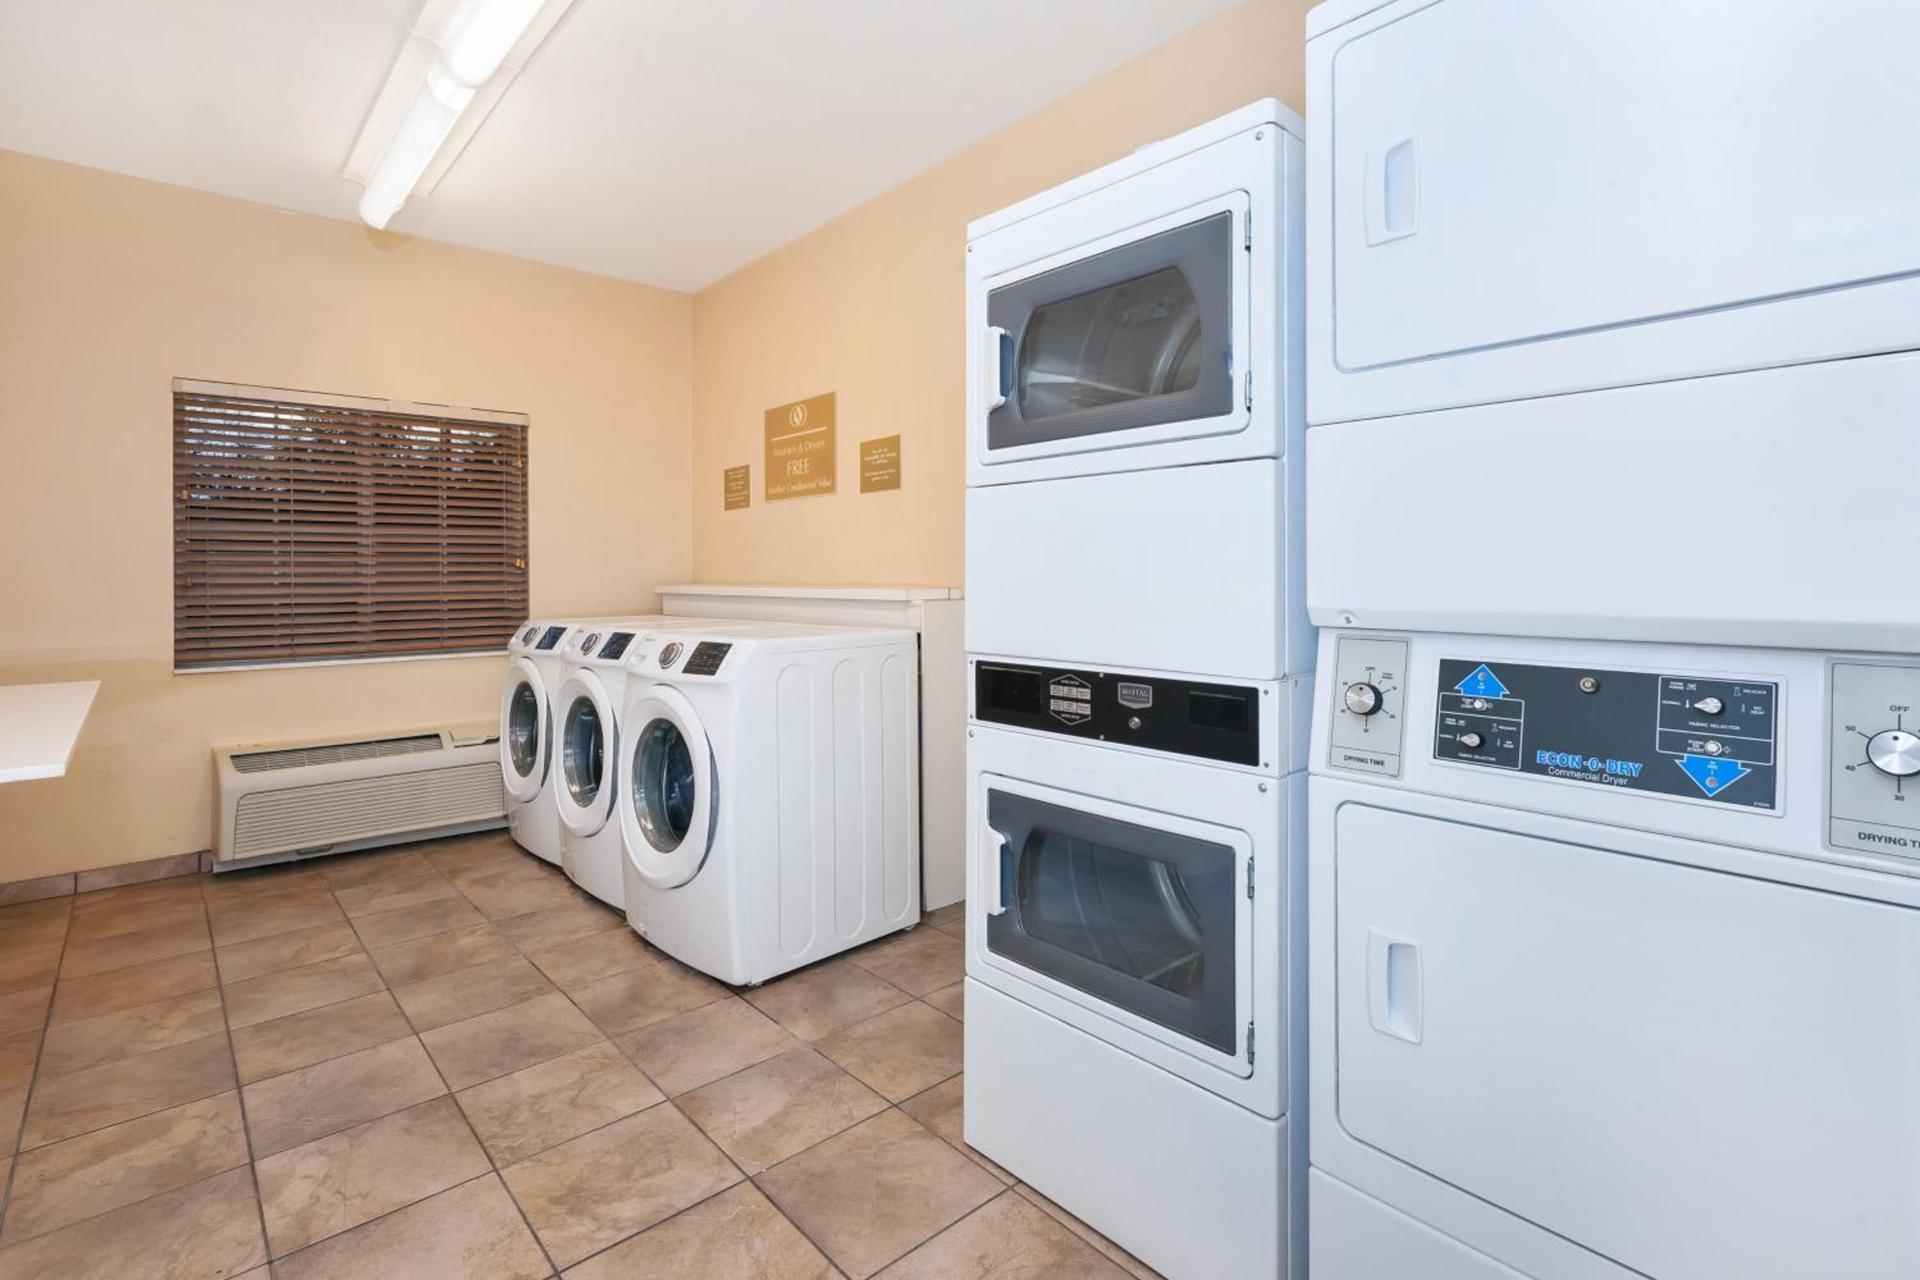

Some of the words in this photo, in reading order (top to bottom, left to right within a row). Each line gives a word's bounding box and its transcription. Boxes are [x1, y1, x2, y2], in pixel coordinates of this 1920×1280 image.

[786, 457, 810, 477] FREE
[1343, 754, 1368, 764] DRYING
[1369, 757, 1385, 767] TIME
[1536, 749, 1644, 777] ECON-O-DRY
[1547, 766, 1600, 781] Commercial
[1601, 773, 1629, 787] Dryer
[1858, 831, 1907, 848] DRYING
